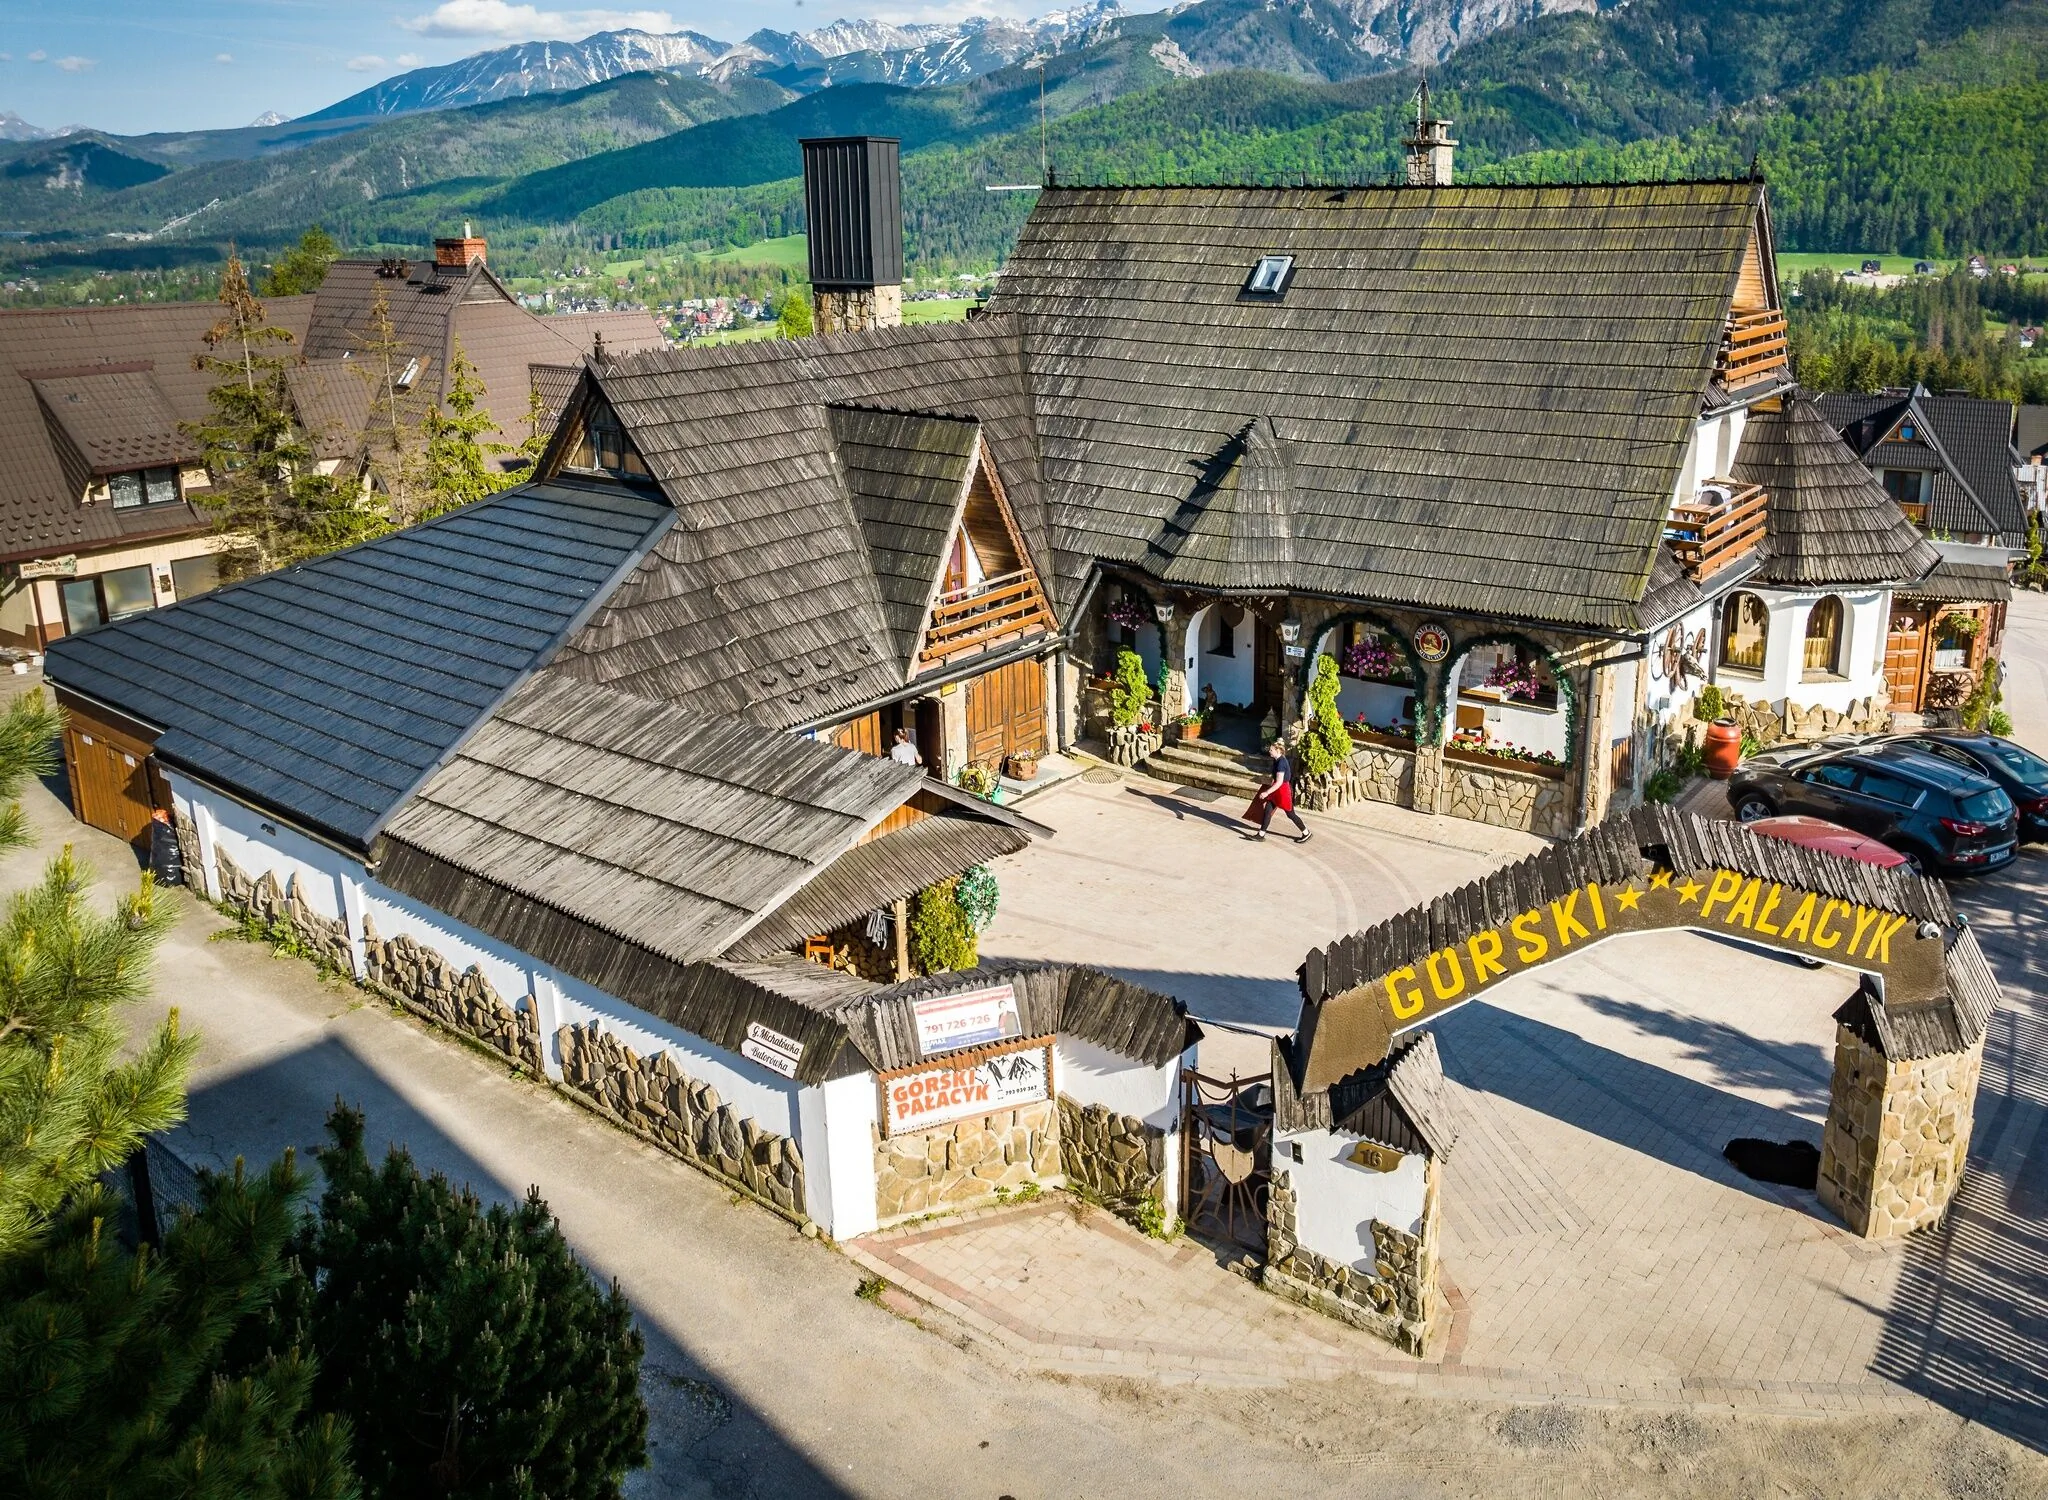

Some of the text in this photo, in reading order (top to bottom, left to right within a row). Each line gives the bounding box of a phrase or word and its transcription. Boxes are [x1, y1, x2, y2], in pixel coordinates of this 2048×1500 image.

[1700, 868, 1907, 964] PAŁACYK
[924, 1014, 991, 1035] 791 726 726
[893, 1069, 977, 1103] GÓRSKI
[896, 1084, 990, 1120] PAŁACYK
[1360, 1149, 1383, 1167] 16
